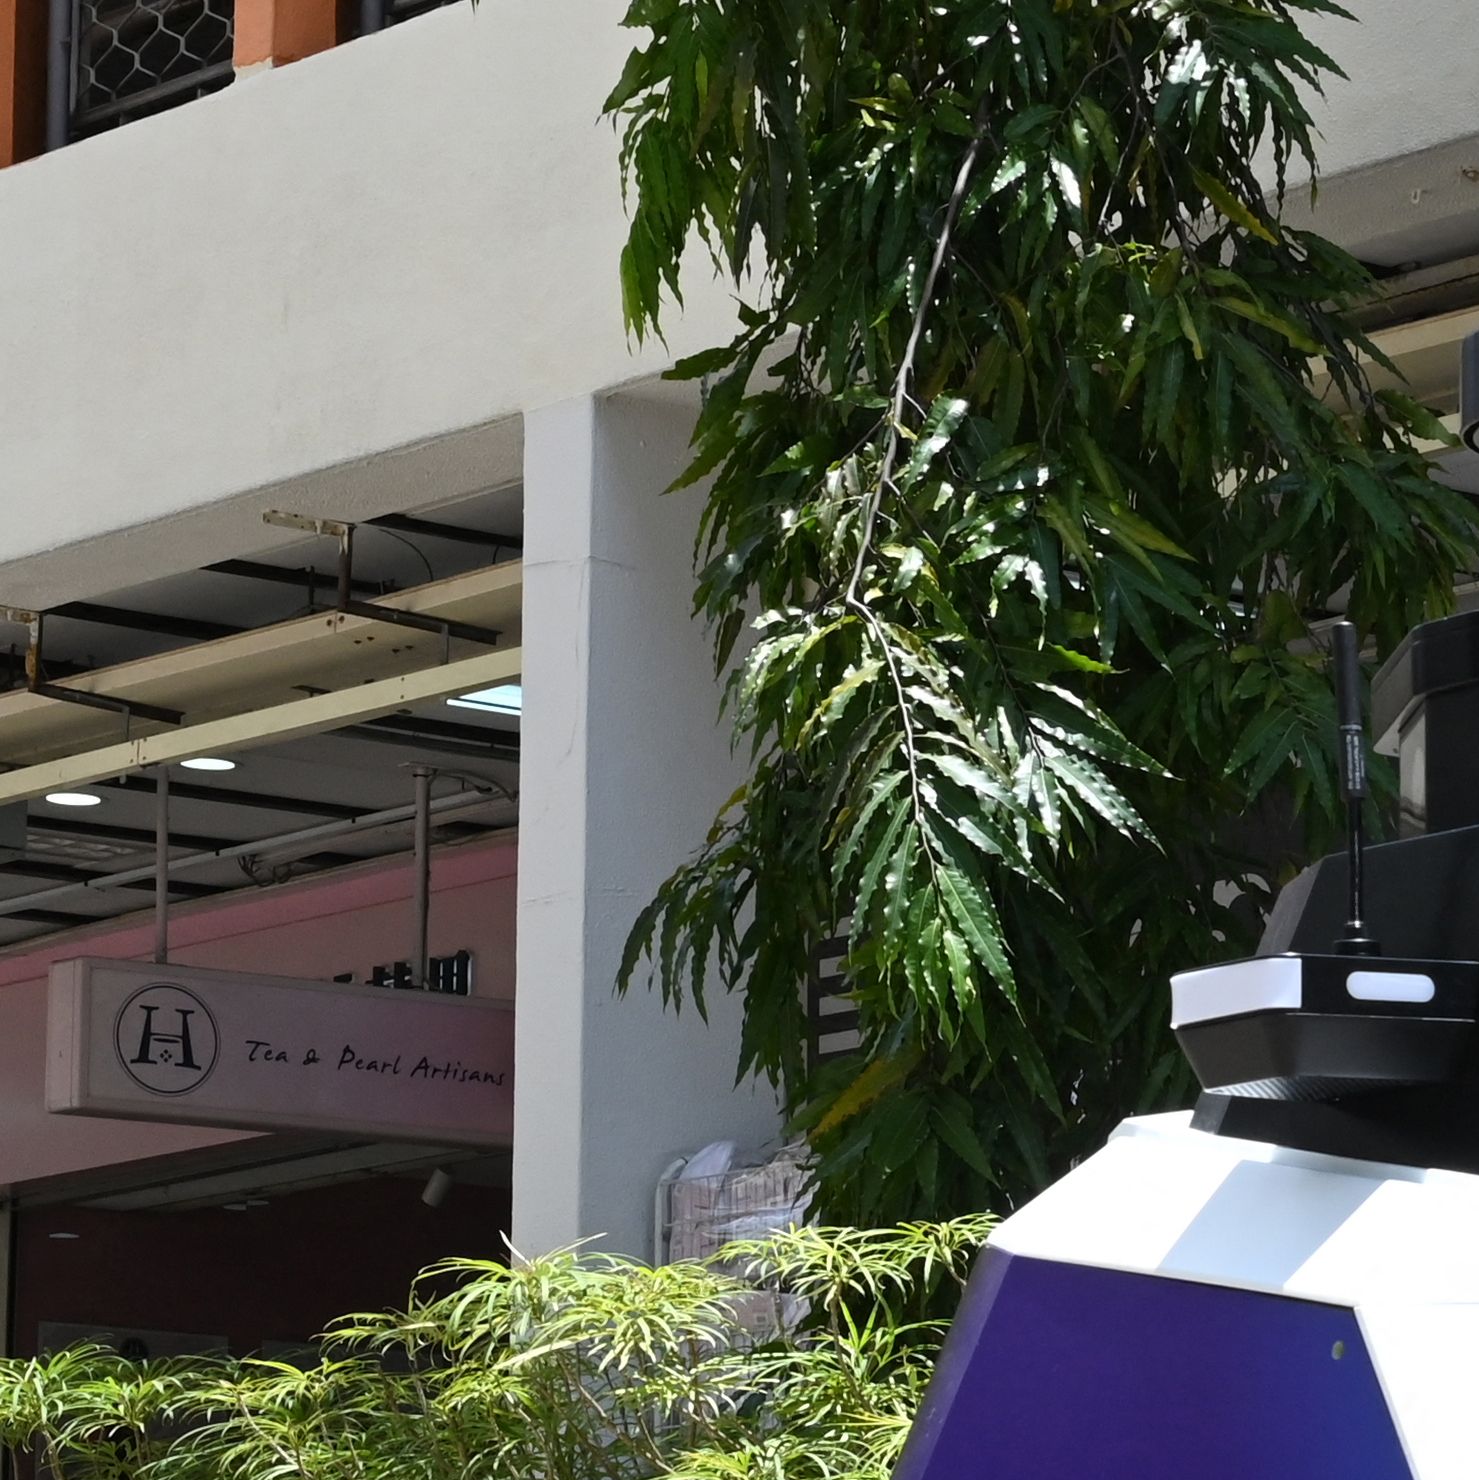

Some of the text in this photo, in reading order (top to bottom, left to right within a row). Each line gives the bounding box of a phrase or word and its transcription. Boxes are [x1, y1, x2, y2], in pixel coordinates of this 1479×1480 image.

[244, 1040, 505, 1088] Tea & Pearl Artisans
